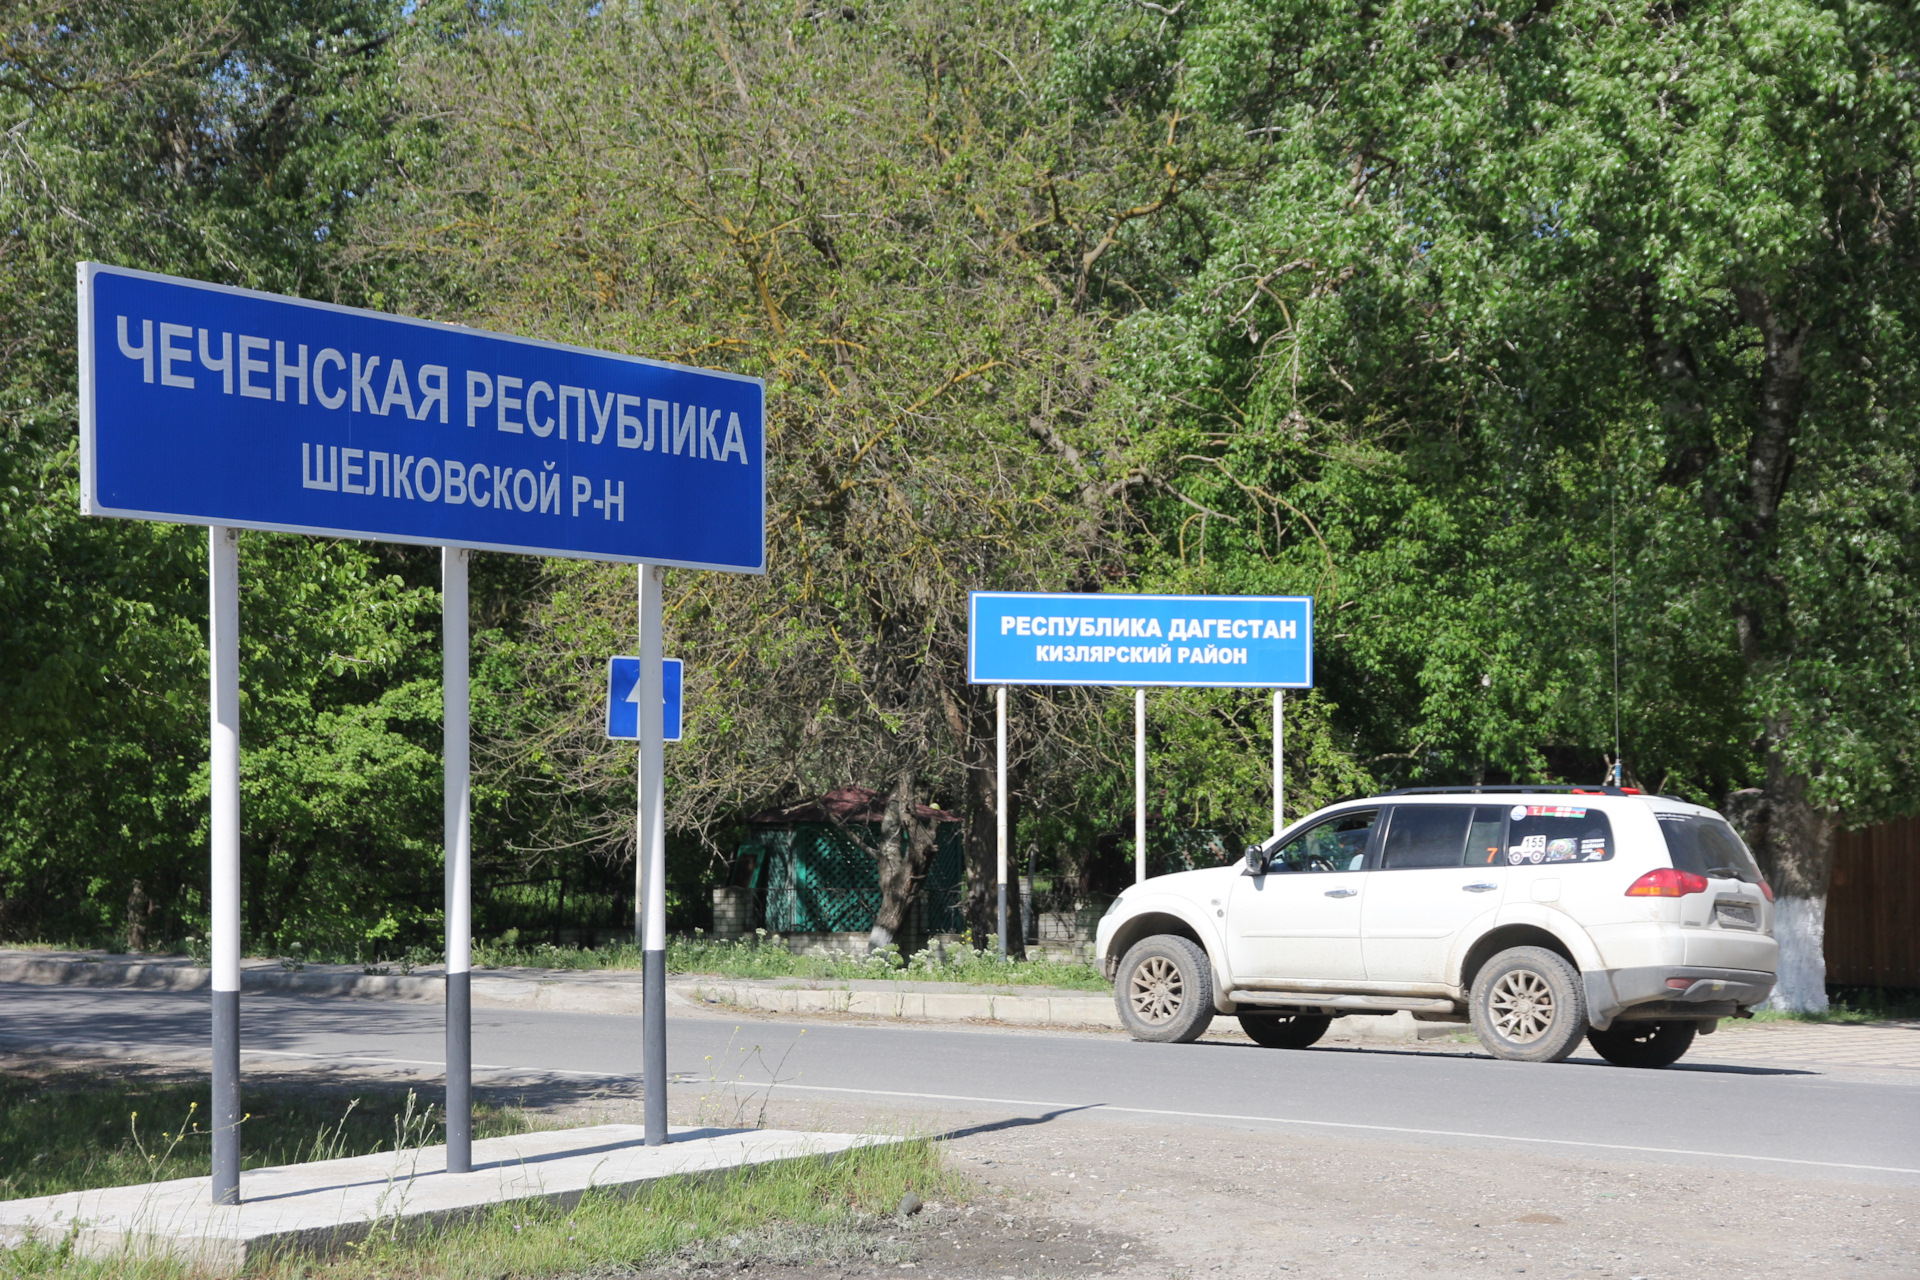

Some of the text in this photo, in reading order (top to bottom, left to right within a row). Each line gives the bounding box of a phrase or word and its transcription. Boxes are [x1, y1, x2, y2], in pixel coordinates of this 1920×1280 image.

[117, 316, 748, 465] ЧЕЧЕНСКАЯ РЕСПУБЛИКА
[302, 443, 625, 521] ШЕЛКОВСКОЙ Р-Н
[1000, 615, 1297, 641] РЕСПУБЛИКА ДАГЕСТАН
[1036, 643, 1248, 665] КИЗЛЯРСКИЙ РАЙОН
[1525, 837, 1545, 849] 155
[1486, 847, 1499, 864] 7
